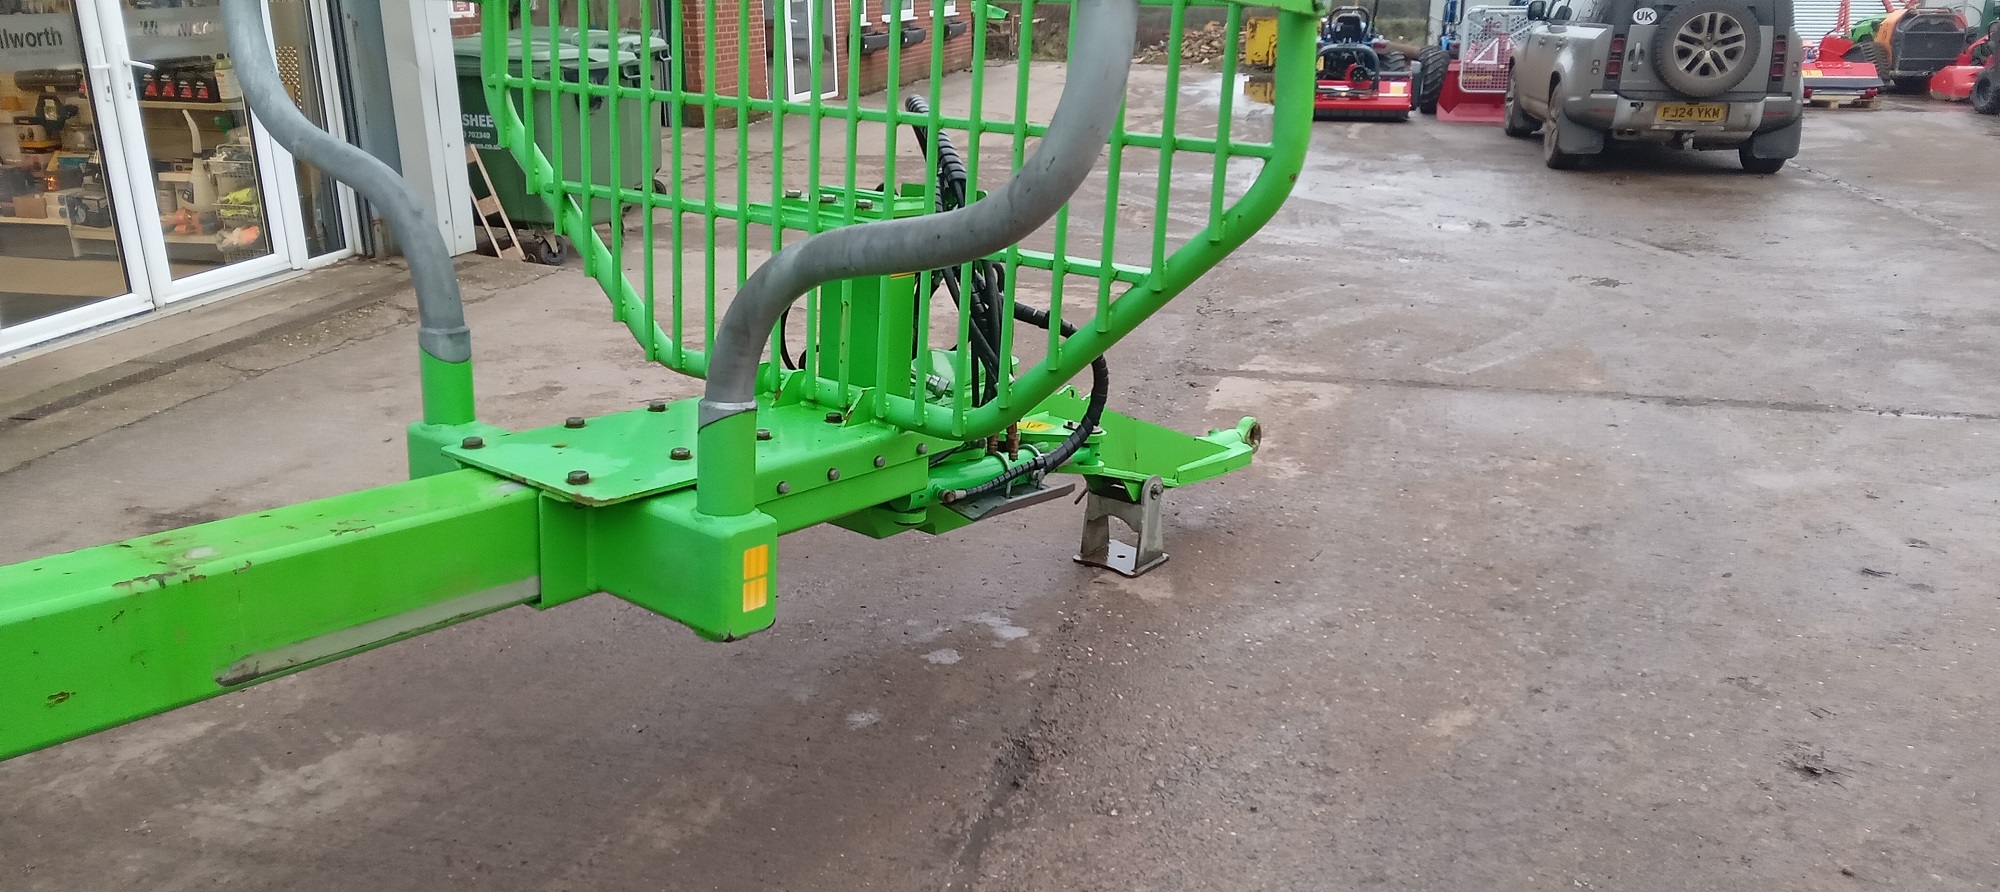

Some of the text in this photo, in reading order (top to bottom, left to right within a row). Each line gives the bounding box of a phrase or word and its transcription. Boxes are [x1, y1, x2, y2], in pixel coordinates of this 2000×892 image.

[1636, 11, 1653, 21] UK
[1662, 107, 1720, 118] FJ24 YKM
